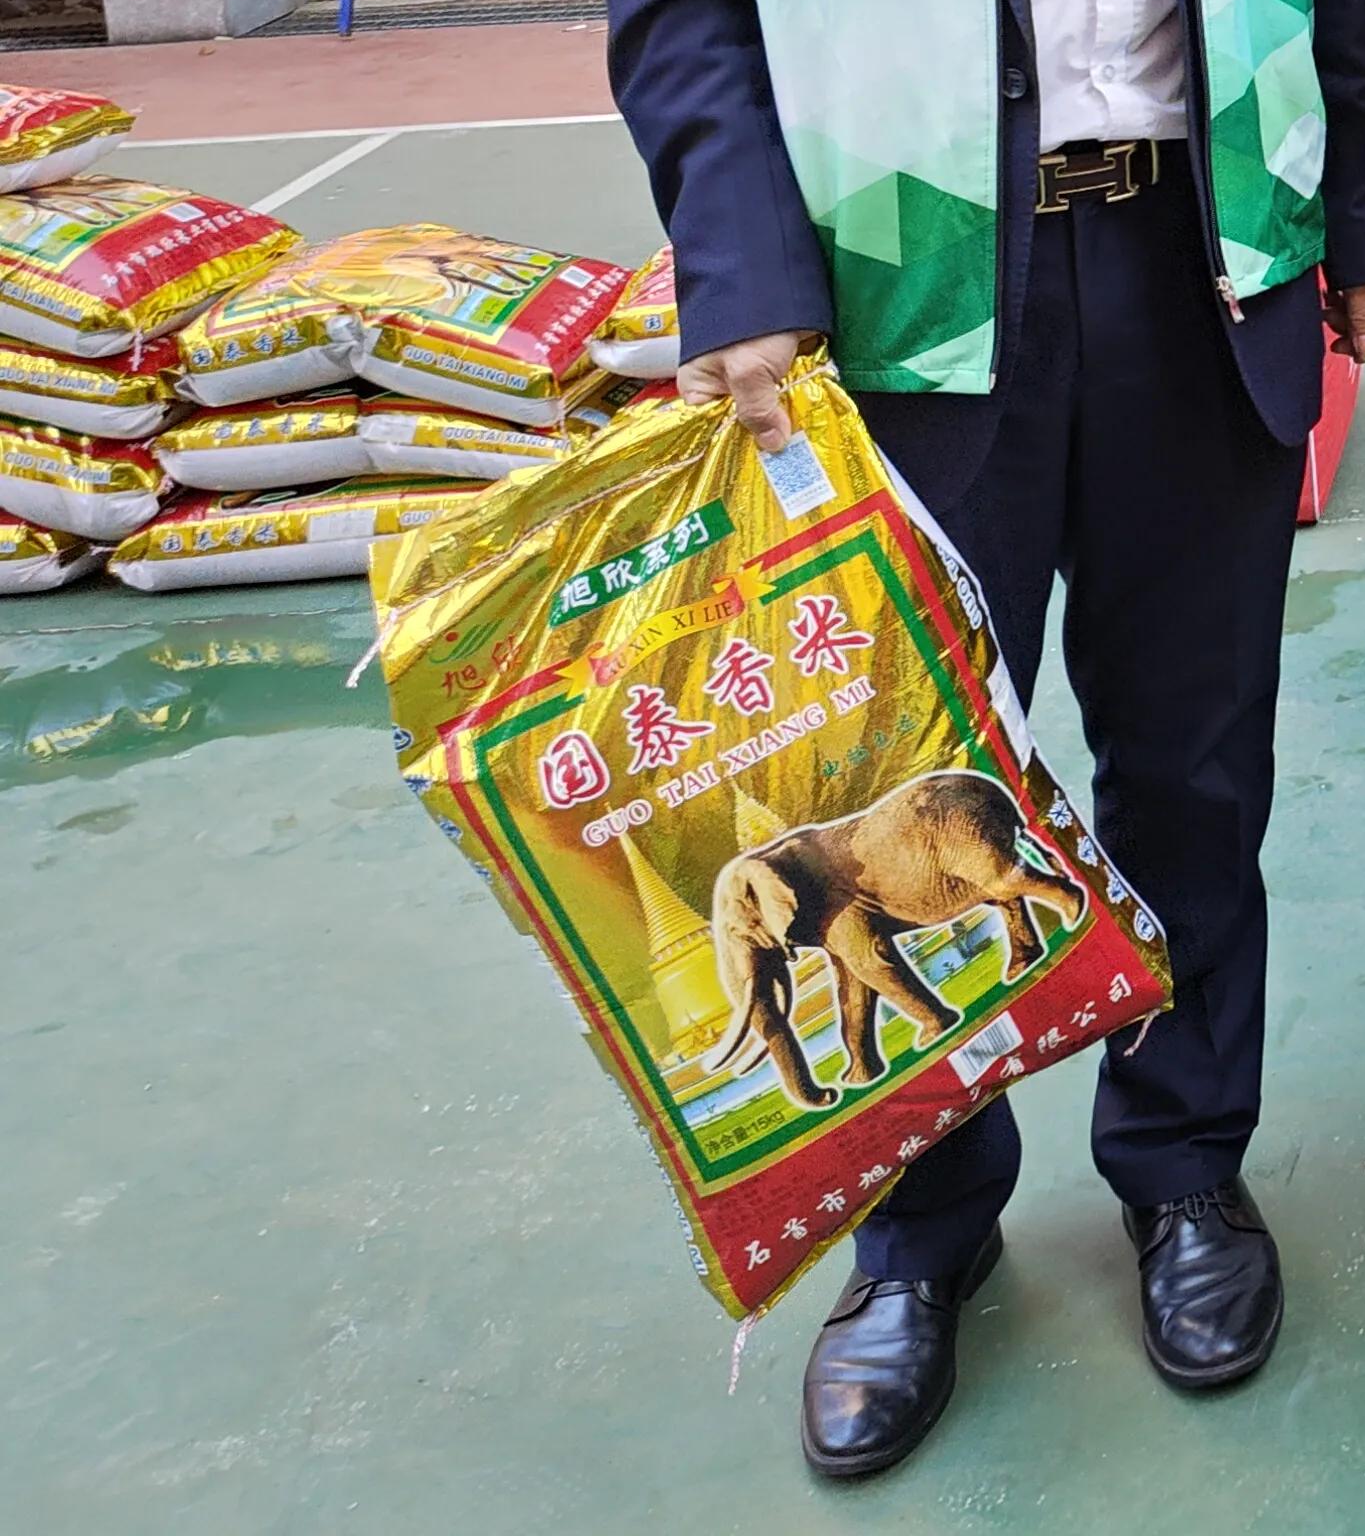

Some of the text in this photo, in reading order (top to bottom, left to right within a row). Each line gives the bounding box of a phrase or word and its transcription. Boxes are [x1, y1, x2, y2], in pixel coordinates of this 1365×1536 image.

[402, 345, 529, 391] GUO TAI XIANG MI
[442, 426, 474, 441] GUO
[477, 429, 502, 443] TAI
[504, 432, 548, 448] XIANG
[559, 511, 711, 614] 旭欣系列
[628, 621, 664, 653] XIN
[672, 609, 696, 633] XI
[702, 598, 735, 625] LIE
[539, 594, 875, 809] 国泰香米
[582, 674, 877, 848] GUO TAI XIANG MI
